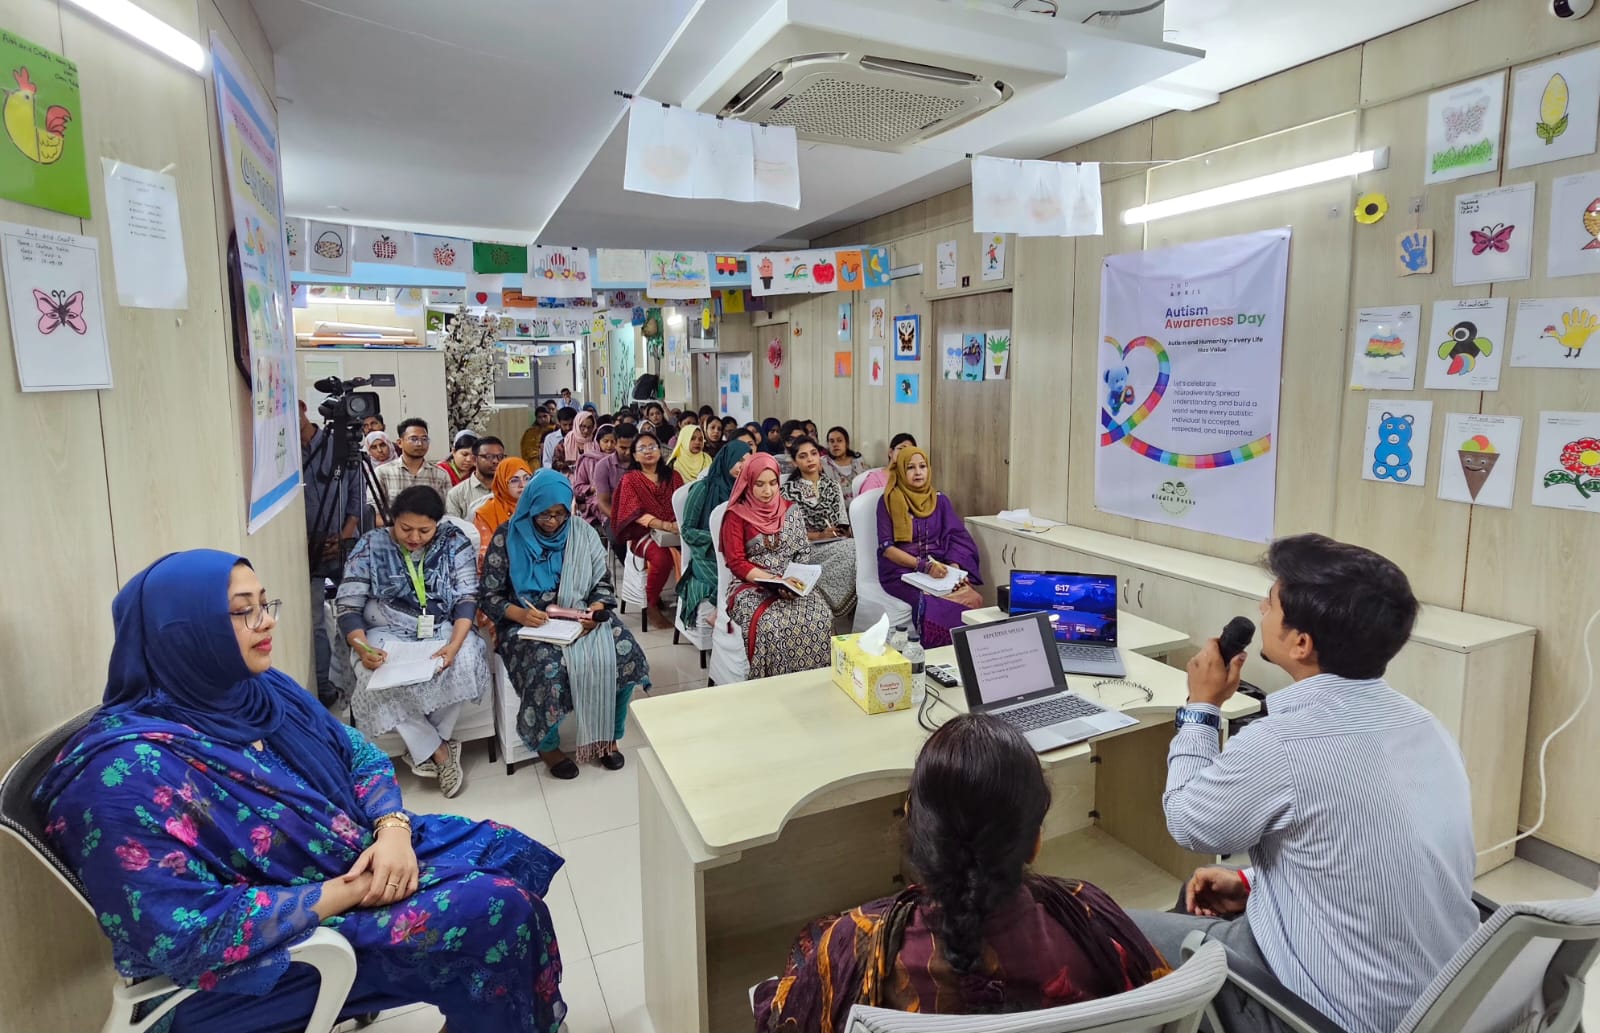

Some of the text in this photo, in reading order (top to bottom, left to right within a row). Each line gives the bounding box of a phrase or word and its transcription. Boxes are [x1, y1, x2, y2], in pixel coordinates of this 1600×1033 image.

[1165, 305, 1208, 318] Autism
[1164, 313, 1266, 329] Awareness Day
[1055, 584, 1070, 592] 6:17
